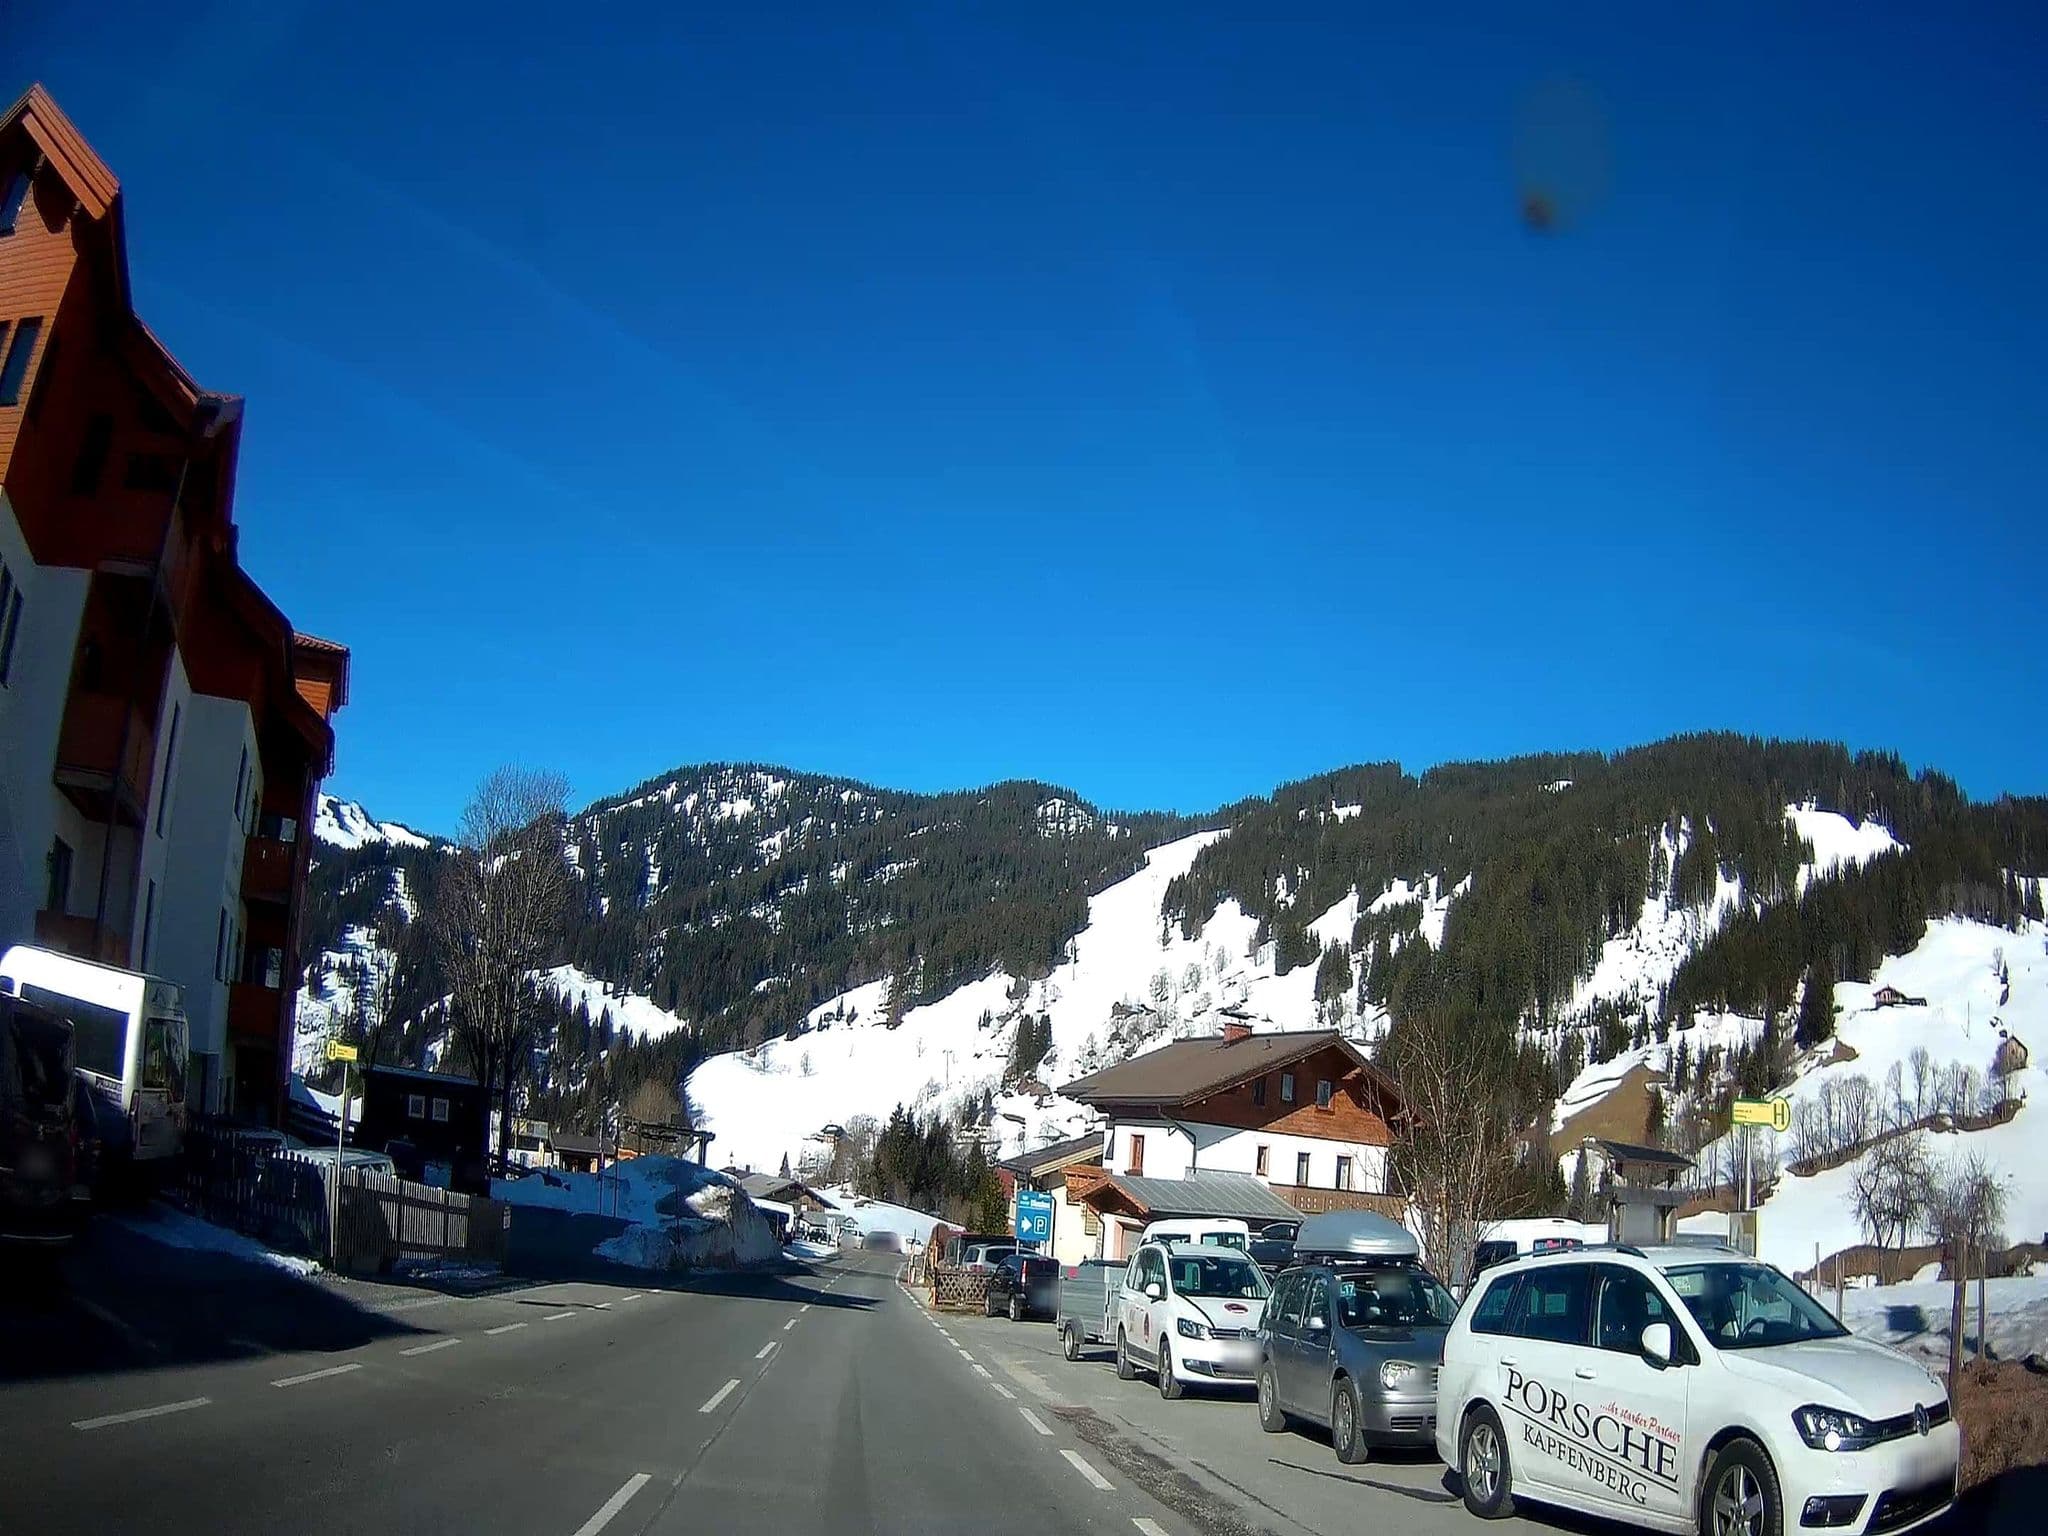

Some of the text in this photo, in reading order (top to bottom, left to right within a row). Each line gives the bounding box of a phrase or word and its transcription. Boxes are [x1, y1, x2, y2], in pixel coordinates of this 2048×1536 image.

[329, 1042, 336, 1057] H
[1773, 1103, 1785, 1125] H
[1036, 1219, 1045, 1232] P
[1503, 1367, 1679, 1483] PORSCHE
[1648, 1416, 1681, 1443] Partner
[1523, 1423, 1648, 1505] KAPFENBERG
